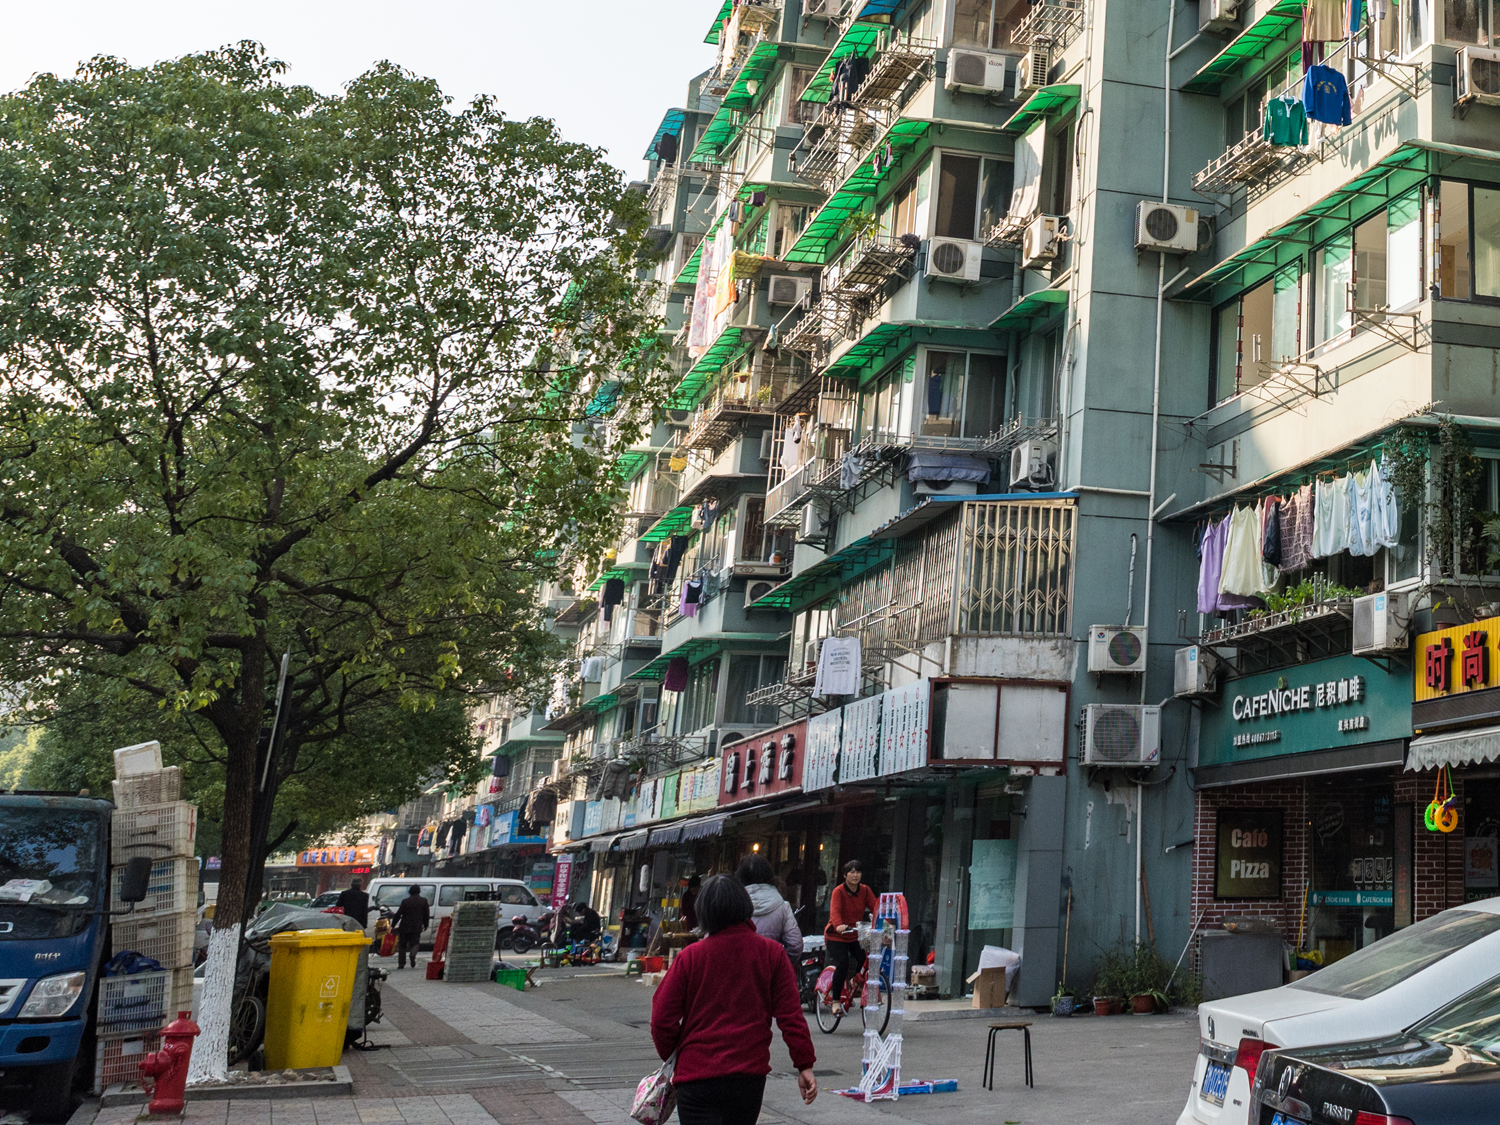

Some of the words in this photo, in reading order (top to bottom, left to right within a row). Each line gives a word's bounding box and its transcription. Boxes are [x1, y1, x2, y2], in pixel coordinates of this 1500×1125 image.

[1231, 828, 1268, 848] Café
[1230, 859, 1270, 879] Pizza
[1322, 1101, 1353, 1121] PASSAT
